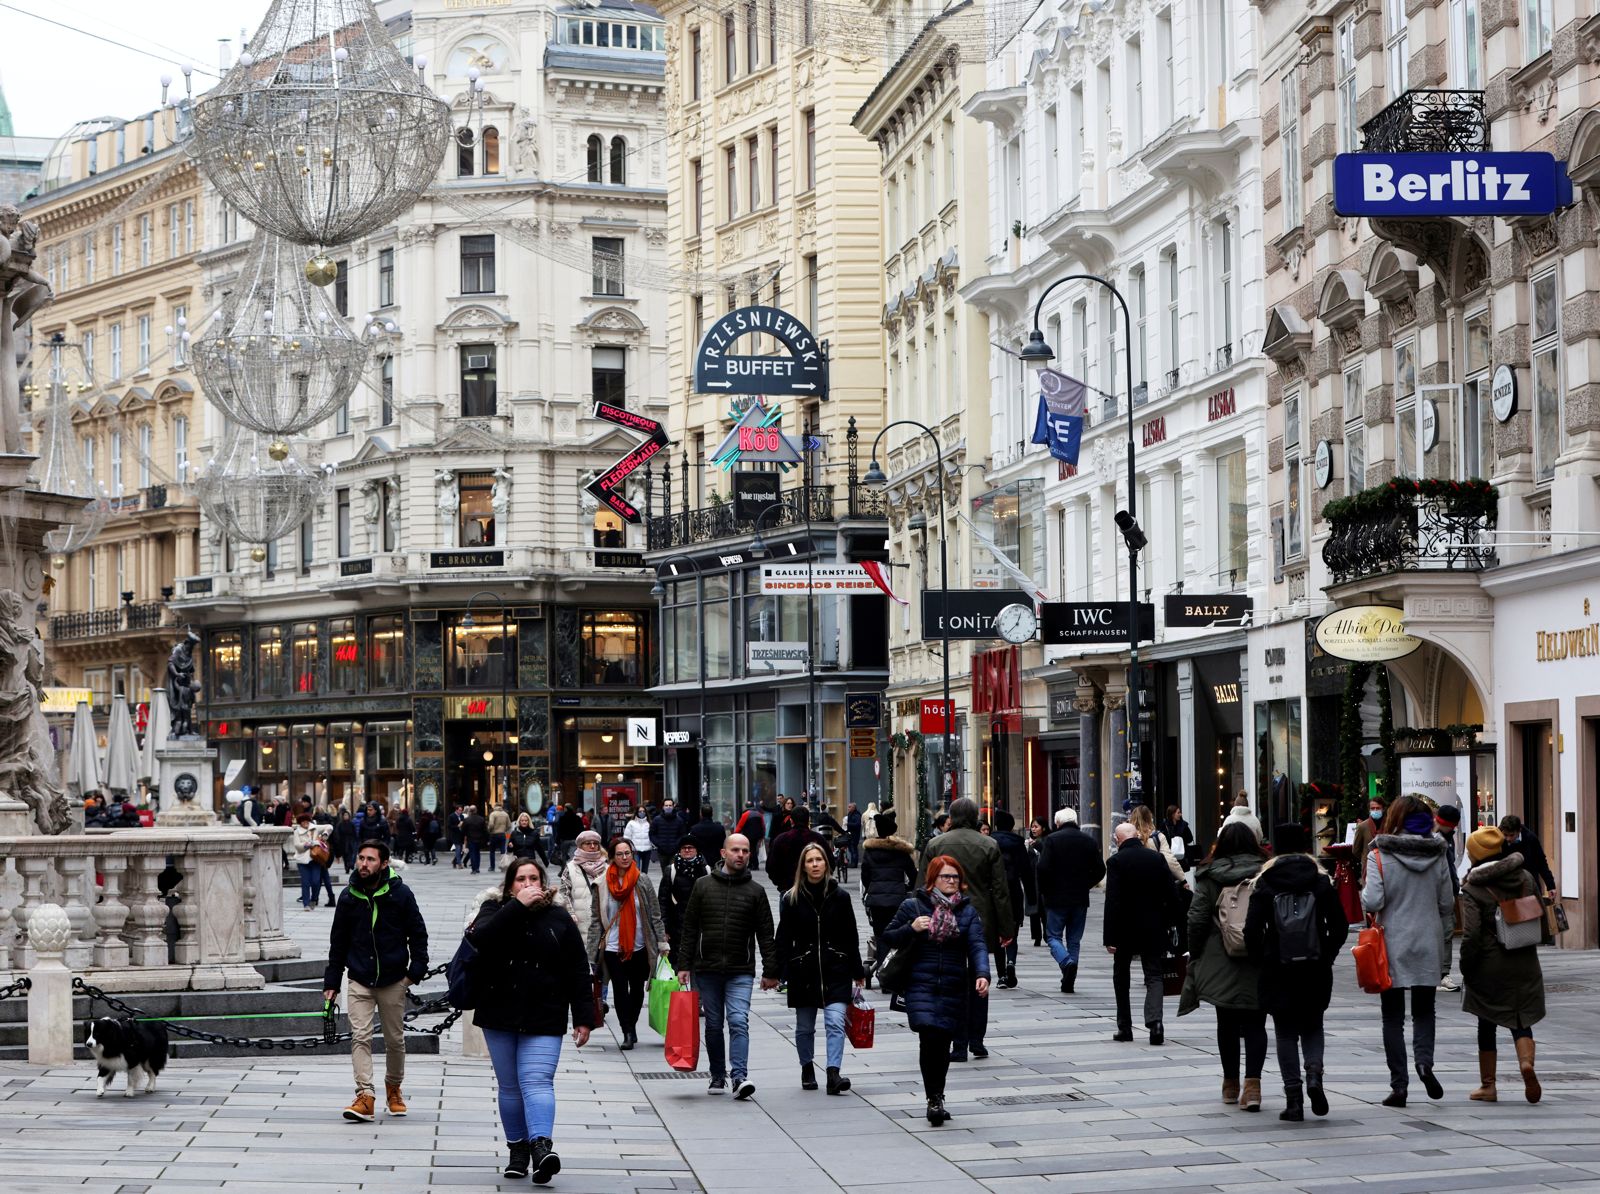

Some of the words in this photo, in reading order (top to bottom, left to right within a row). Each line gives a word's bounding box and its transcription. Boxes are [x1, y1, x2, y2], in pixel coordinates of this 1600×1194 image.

[1362, 159, 1531, 202] Berlitz
[704, 311, 818, 371] TRZEŚNIEWSKI
[726, 360, 795, 376] BUFFET
[1493, 382, 1512, 401] KNIZE
[1207, 387, 1236, 422] LISKA
[601, 405, 657, 430] DISCOTHEQUE
[738, 426, 780, 451] Köö
[1142, 415, 1167, 448] LISKA
[600, 442, 660, 491] FLEDERMAUS
[610, 495, 626, 510] BAR
[448, 555, 476, 565] BRAUN
[1073, 608, 1113, 626] IWC
[1185, 606, 1229, 616] BALLY
[1324, 619, 1368, 635] Albin
[1536, 622, 1600, 662] HELDWEIN
[1214, 684, 1240, 703] BALLY
[663, 730, 689, 745] NESPRESSO
[1415, 780, 1452, 788] Aufgetischt!
